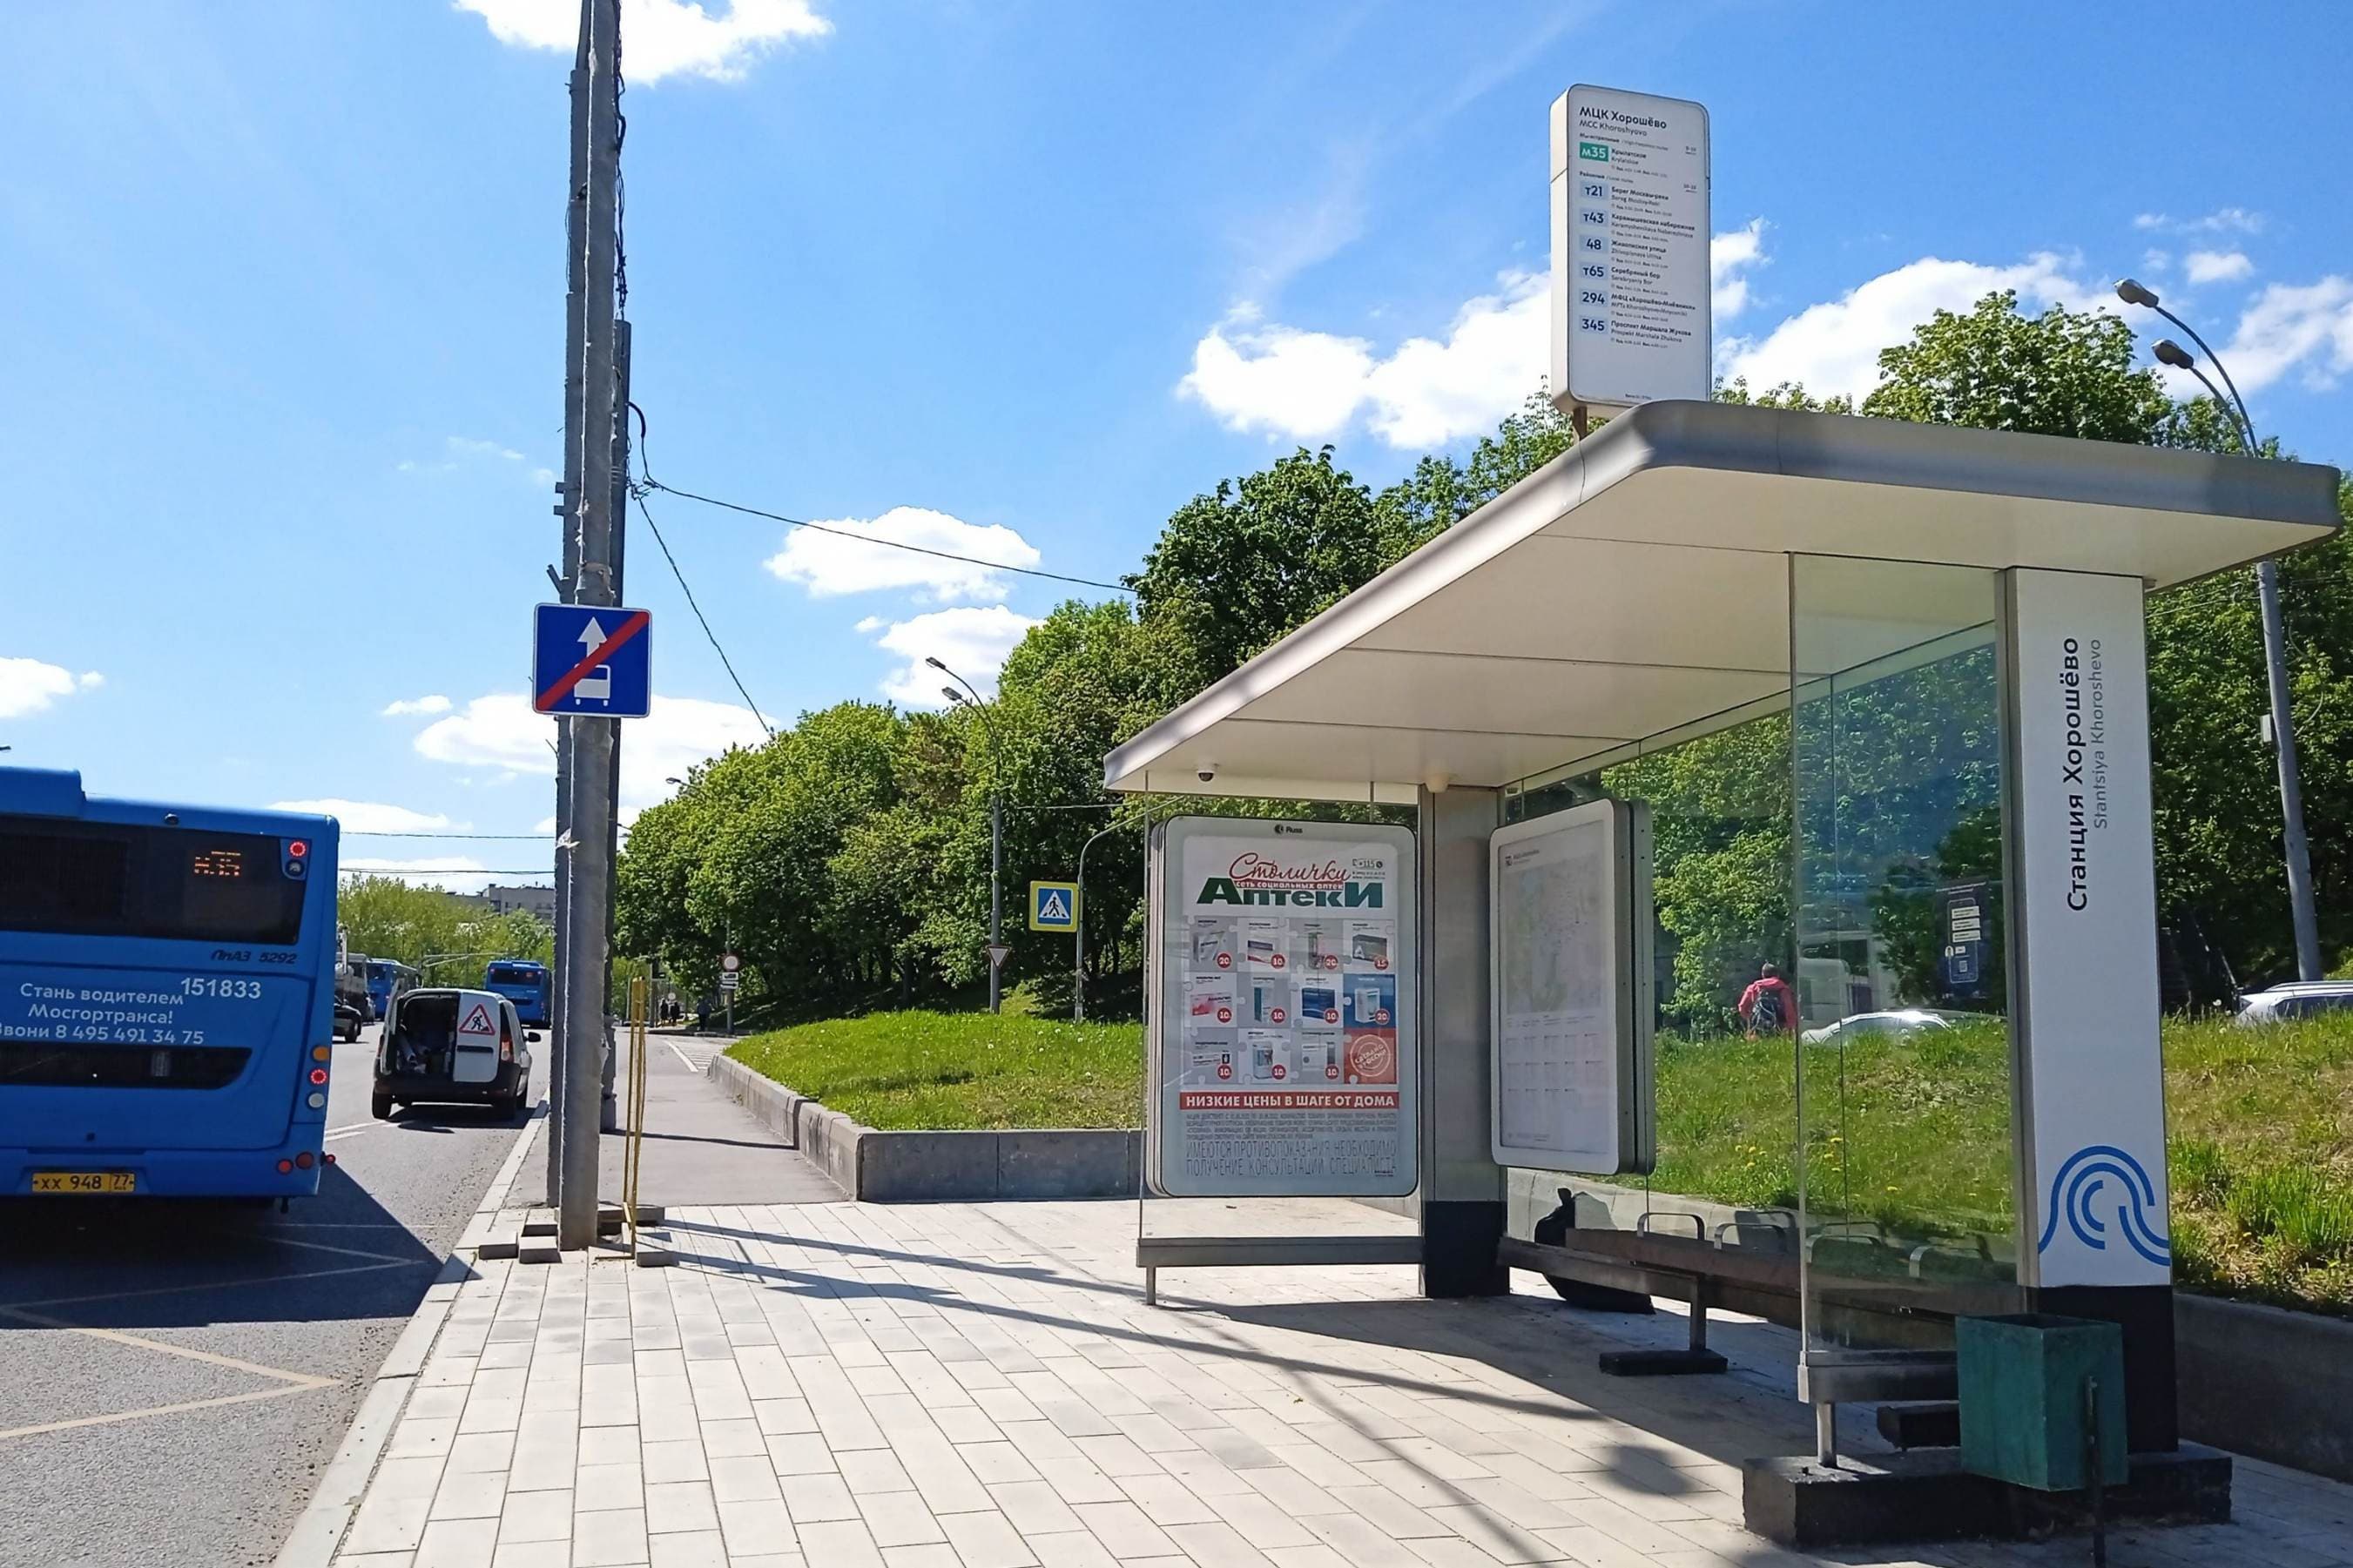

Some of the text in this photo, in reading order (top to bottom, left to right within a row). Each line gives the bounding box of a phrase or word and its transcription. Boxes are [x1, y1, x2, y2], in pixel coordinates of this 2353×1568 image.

[1579, 105, 1668, 130] МЦК Хорошёво
[1581, 146, 1606, 159] м35
[1585, 185, 1603, 198] т21
[1583, 212, 1605, 225] т43
[1586, 239, 1601, 251] 48
[1583, 265, 1605, 278] т65
[1581, 291, 1605, 305] 294
[1581, 318, 1605, 332] 345
[2087, 638, 2108, 829] Stantsiya Khoroshevo
[2059, 637, 2088, 912] Станция Хорошёво
[1229, 852, 1352, 881] Столички
[1257, 880, 1315, 889] социальных
[259, 952, 298, 965] 5292
[20, 982, 184, 1006] Стань водителем
[180, 977, 261, 999] 151833
[27, 1003, 174, 1026] Мосгортранса!
[0, 1022, 205, 1045] вони 8 495 491 34 75
[1186, 1095, 1395, 1108] НИЗКИЕ ЦЕНЫ В ШАГЕ ОТ ДОМА
[70, 1174, 102, 1190] 948
[112, 1174, 130, 1186] 77
